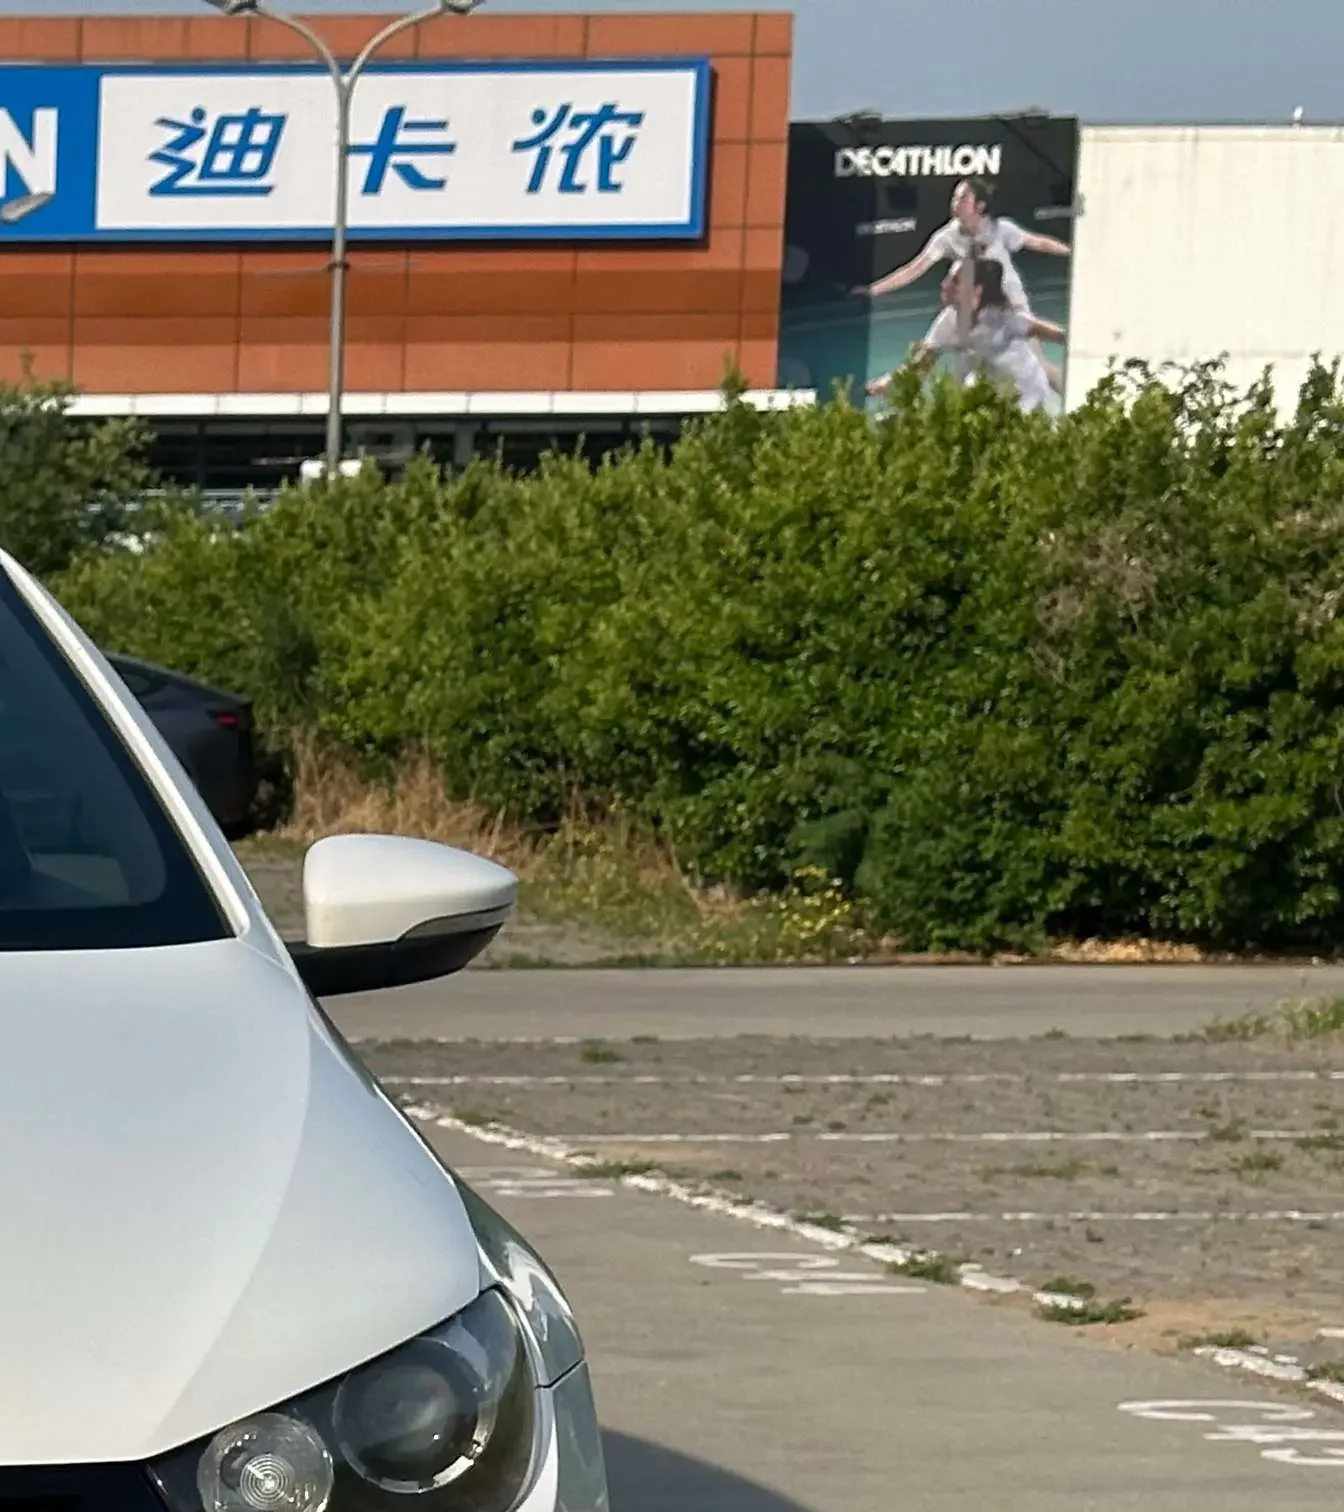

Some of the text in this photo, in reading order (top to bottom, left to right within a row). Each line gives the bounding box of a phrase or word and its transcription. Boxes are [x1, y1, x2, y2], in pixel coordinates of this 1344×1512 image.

[148, 103, 645, 197] 迪卡侬
[834, 144, 1002, 177] DECATHLON
